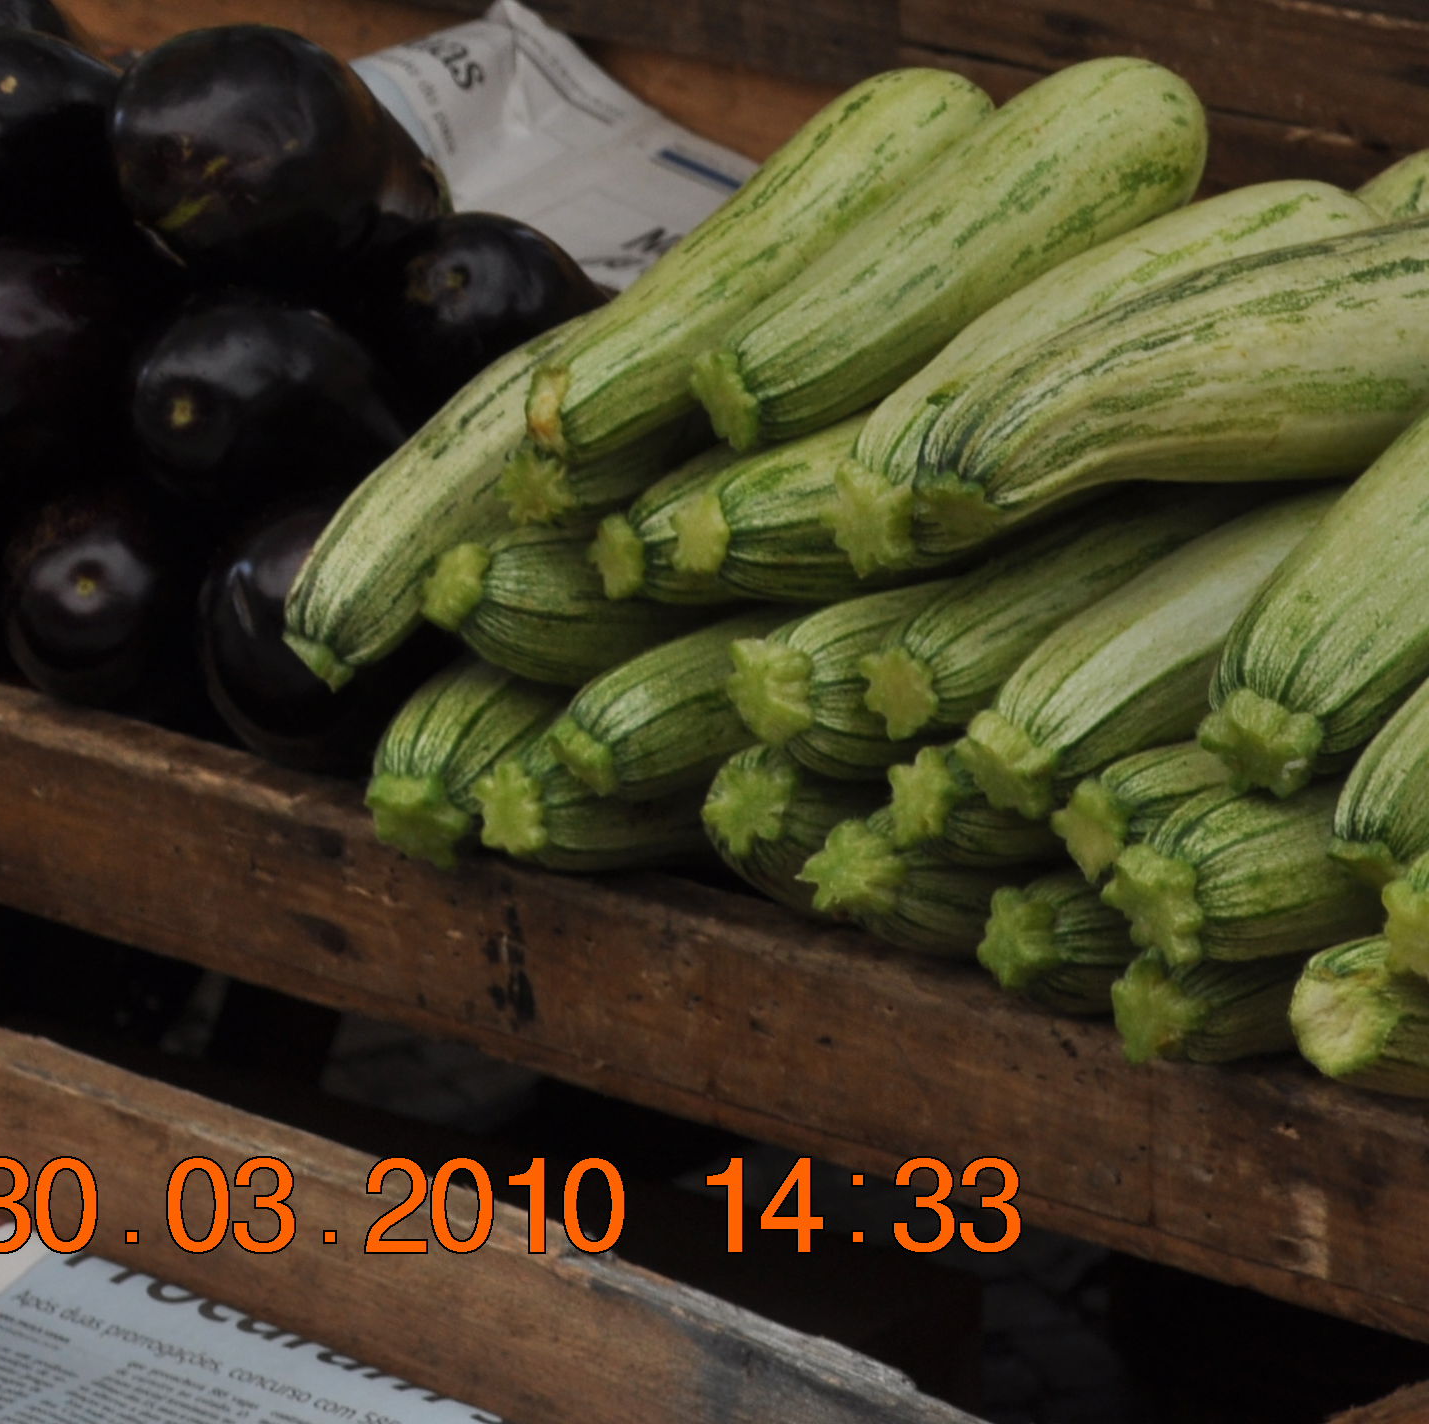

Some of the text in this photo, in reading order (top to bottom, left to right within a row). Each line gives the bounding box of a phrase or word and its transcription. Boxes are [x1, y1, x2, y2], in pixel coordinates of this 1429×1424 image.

[59, 1307, 103, 1330] duas
[229, 1367, 312, 1404] concurso
[313, 1397, 357, 1420] com
